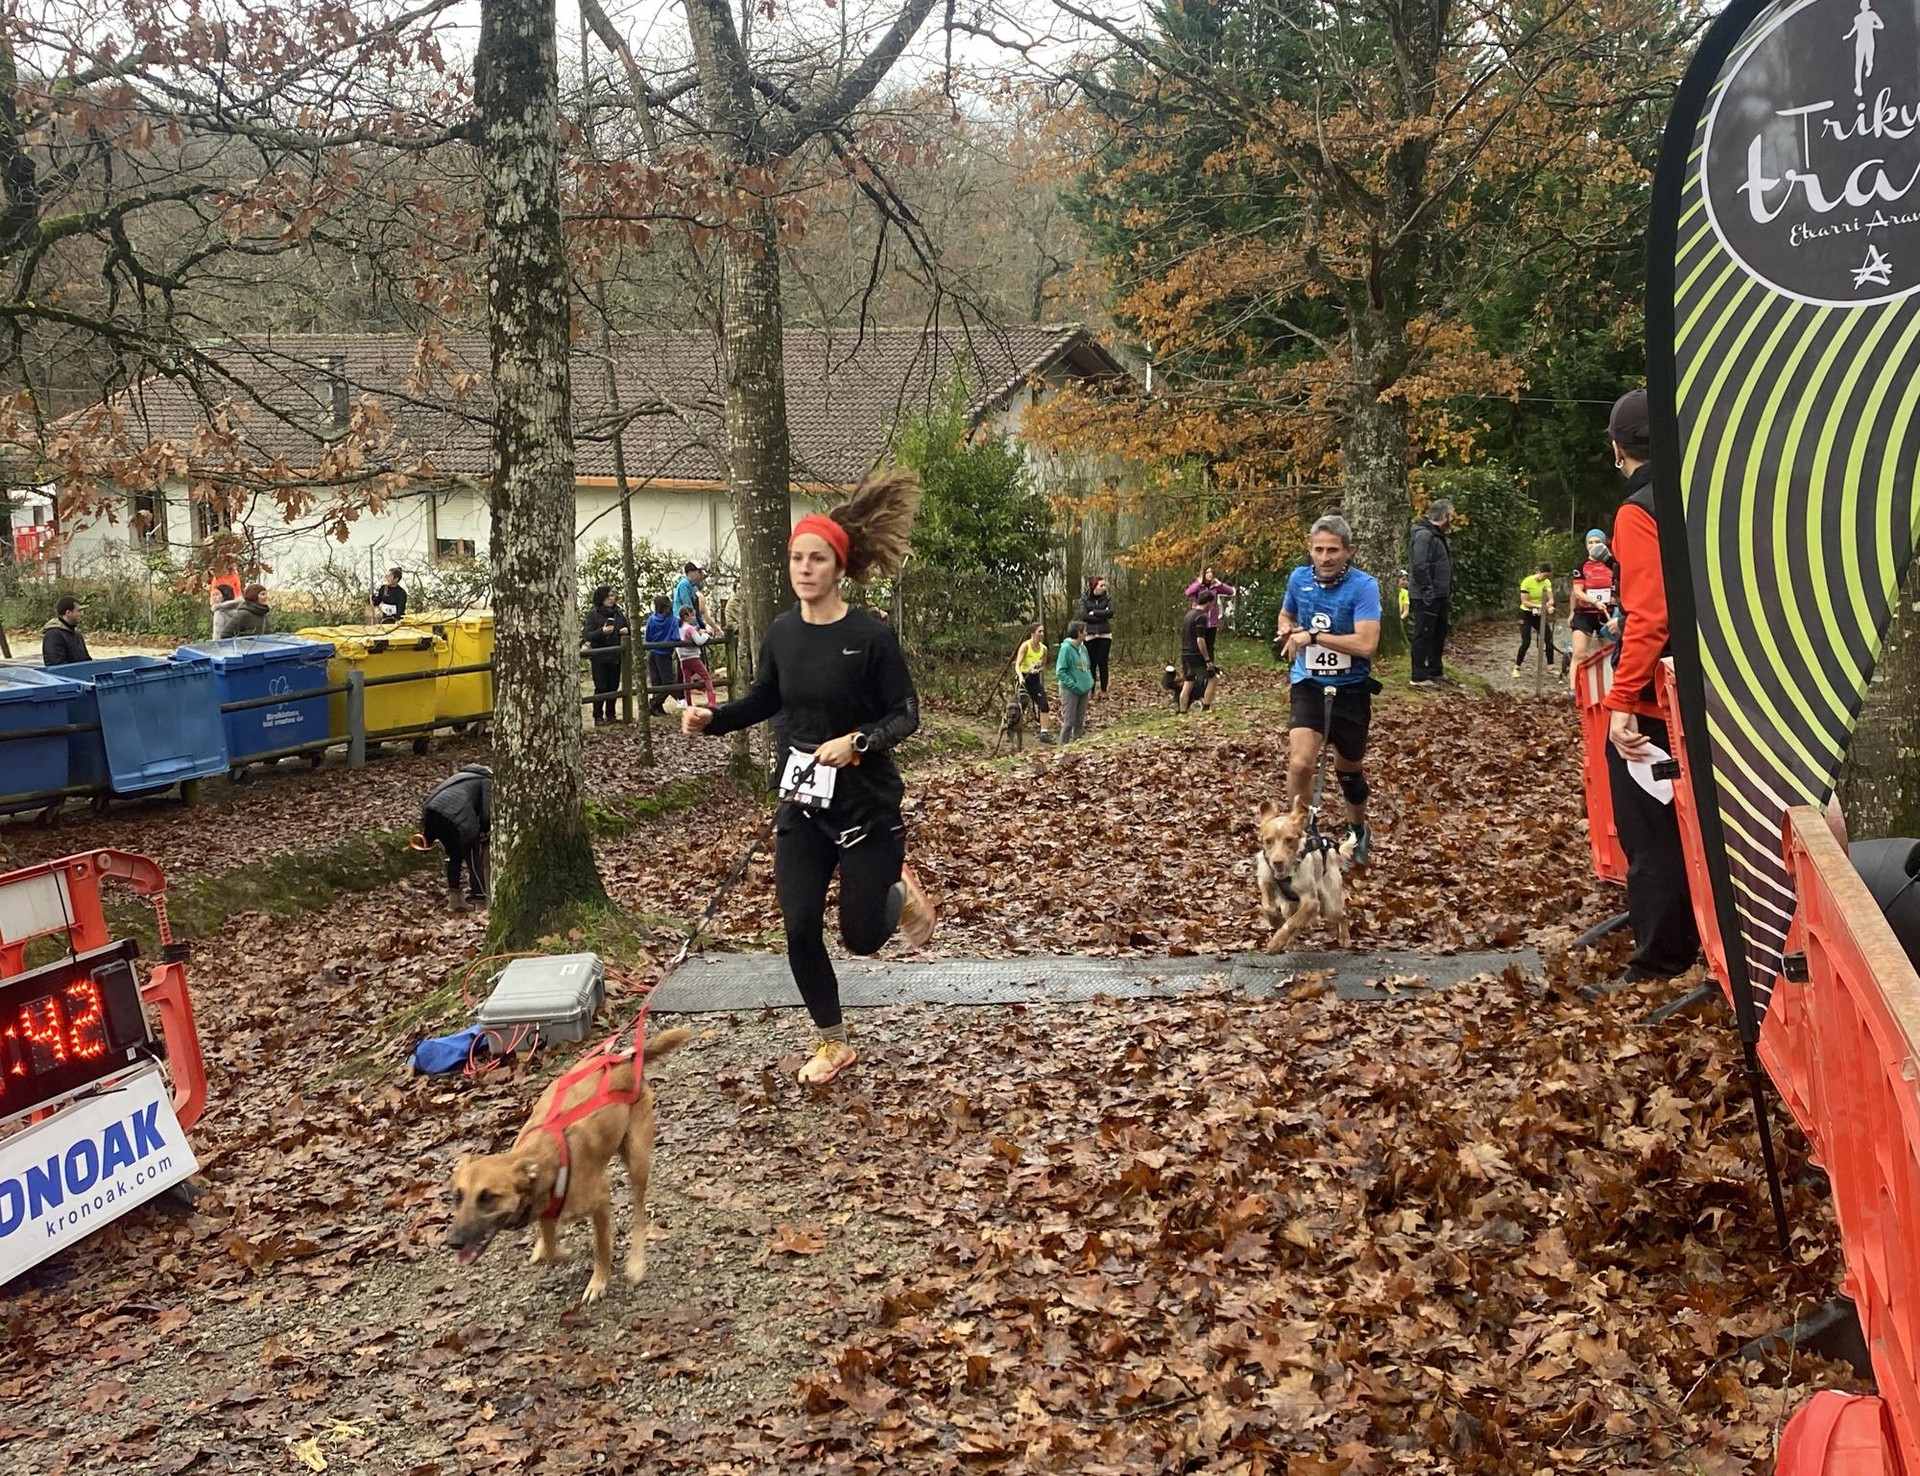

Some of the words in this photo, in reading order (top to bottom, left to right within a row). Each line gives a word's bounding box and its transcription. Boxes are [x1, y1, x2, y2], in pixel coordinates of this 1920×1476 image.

[1315, 652, 1338, 666] 48
[0, 1100, 166, 1238] ONOAK
[45, 1155, 173, 1238] kronoak.com
